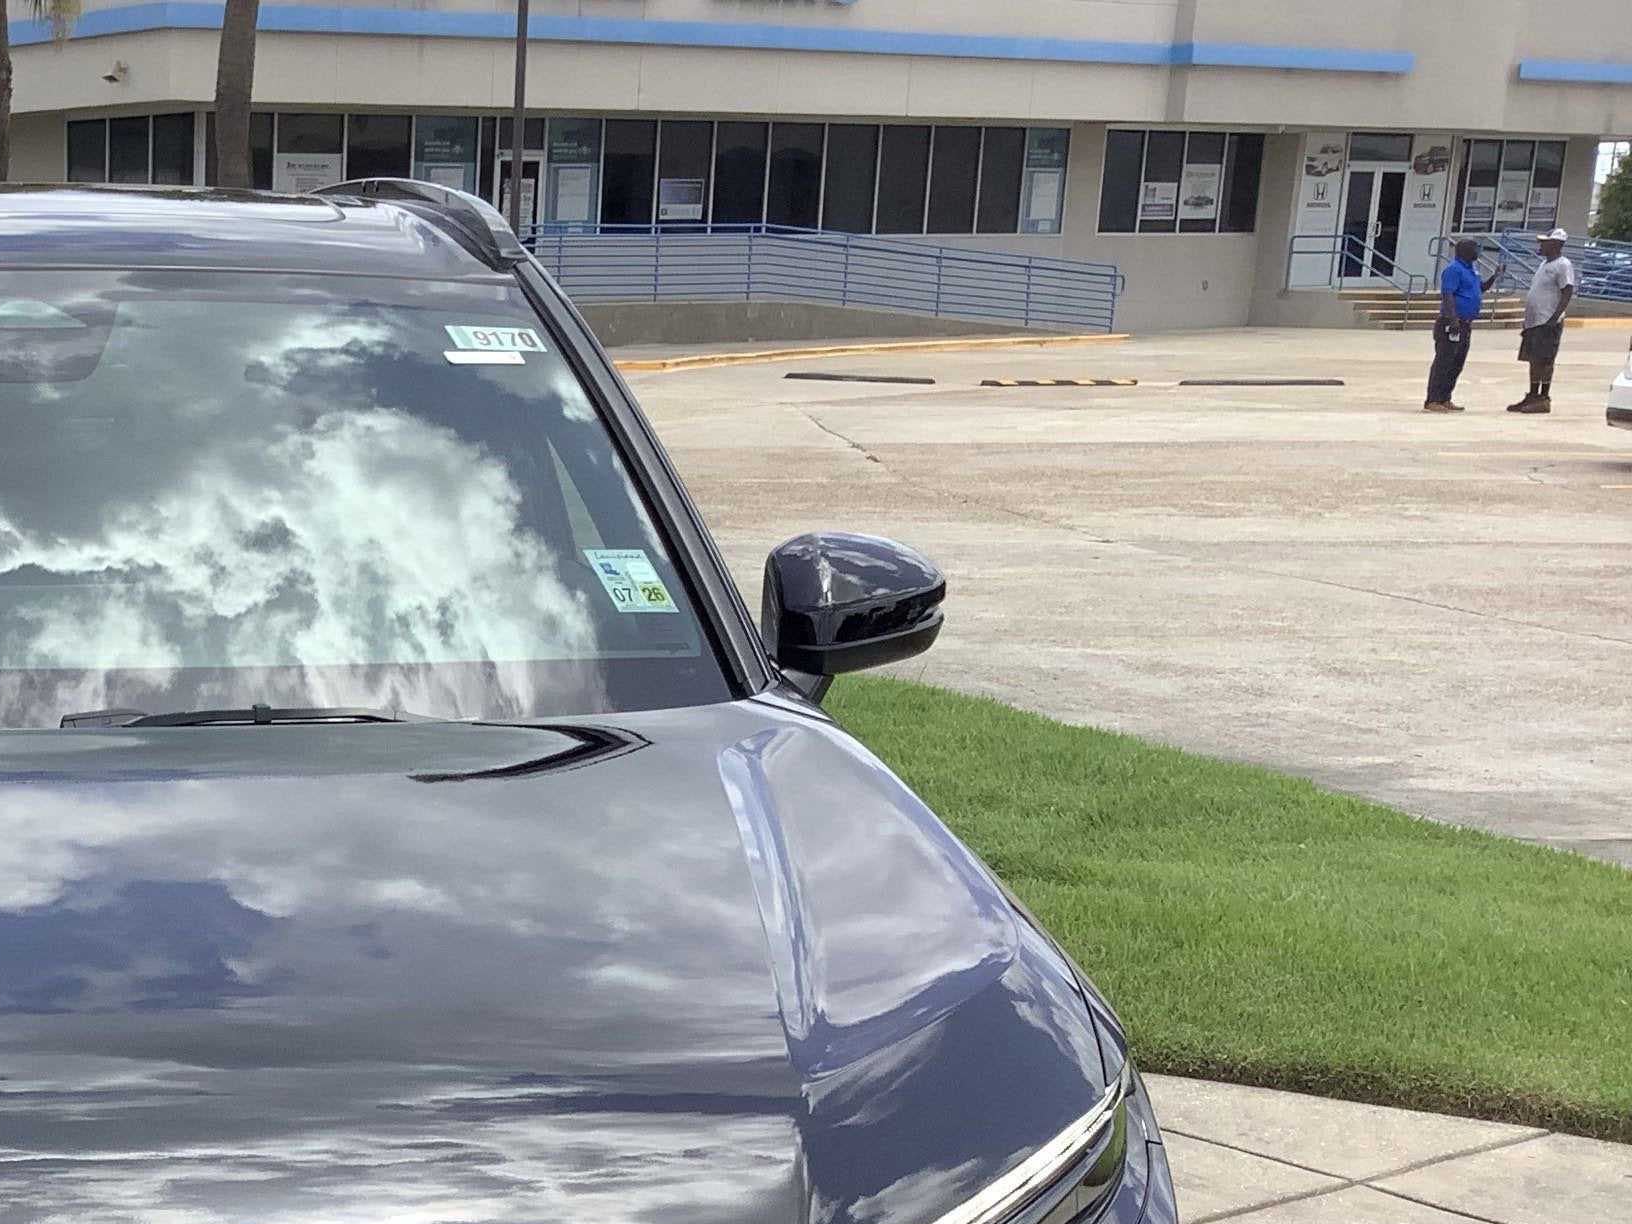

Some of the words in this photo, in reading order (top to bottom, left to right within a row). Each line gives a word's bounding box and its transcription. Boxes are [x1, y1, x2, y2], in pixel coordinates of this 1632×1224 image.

[472, 330, 538, 348] 9170
[613, 587, 633, 602] 07
[641, 587, 665, 602] 26
